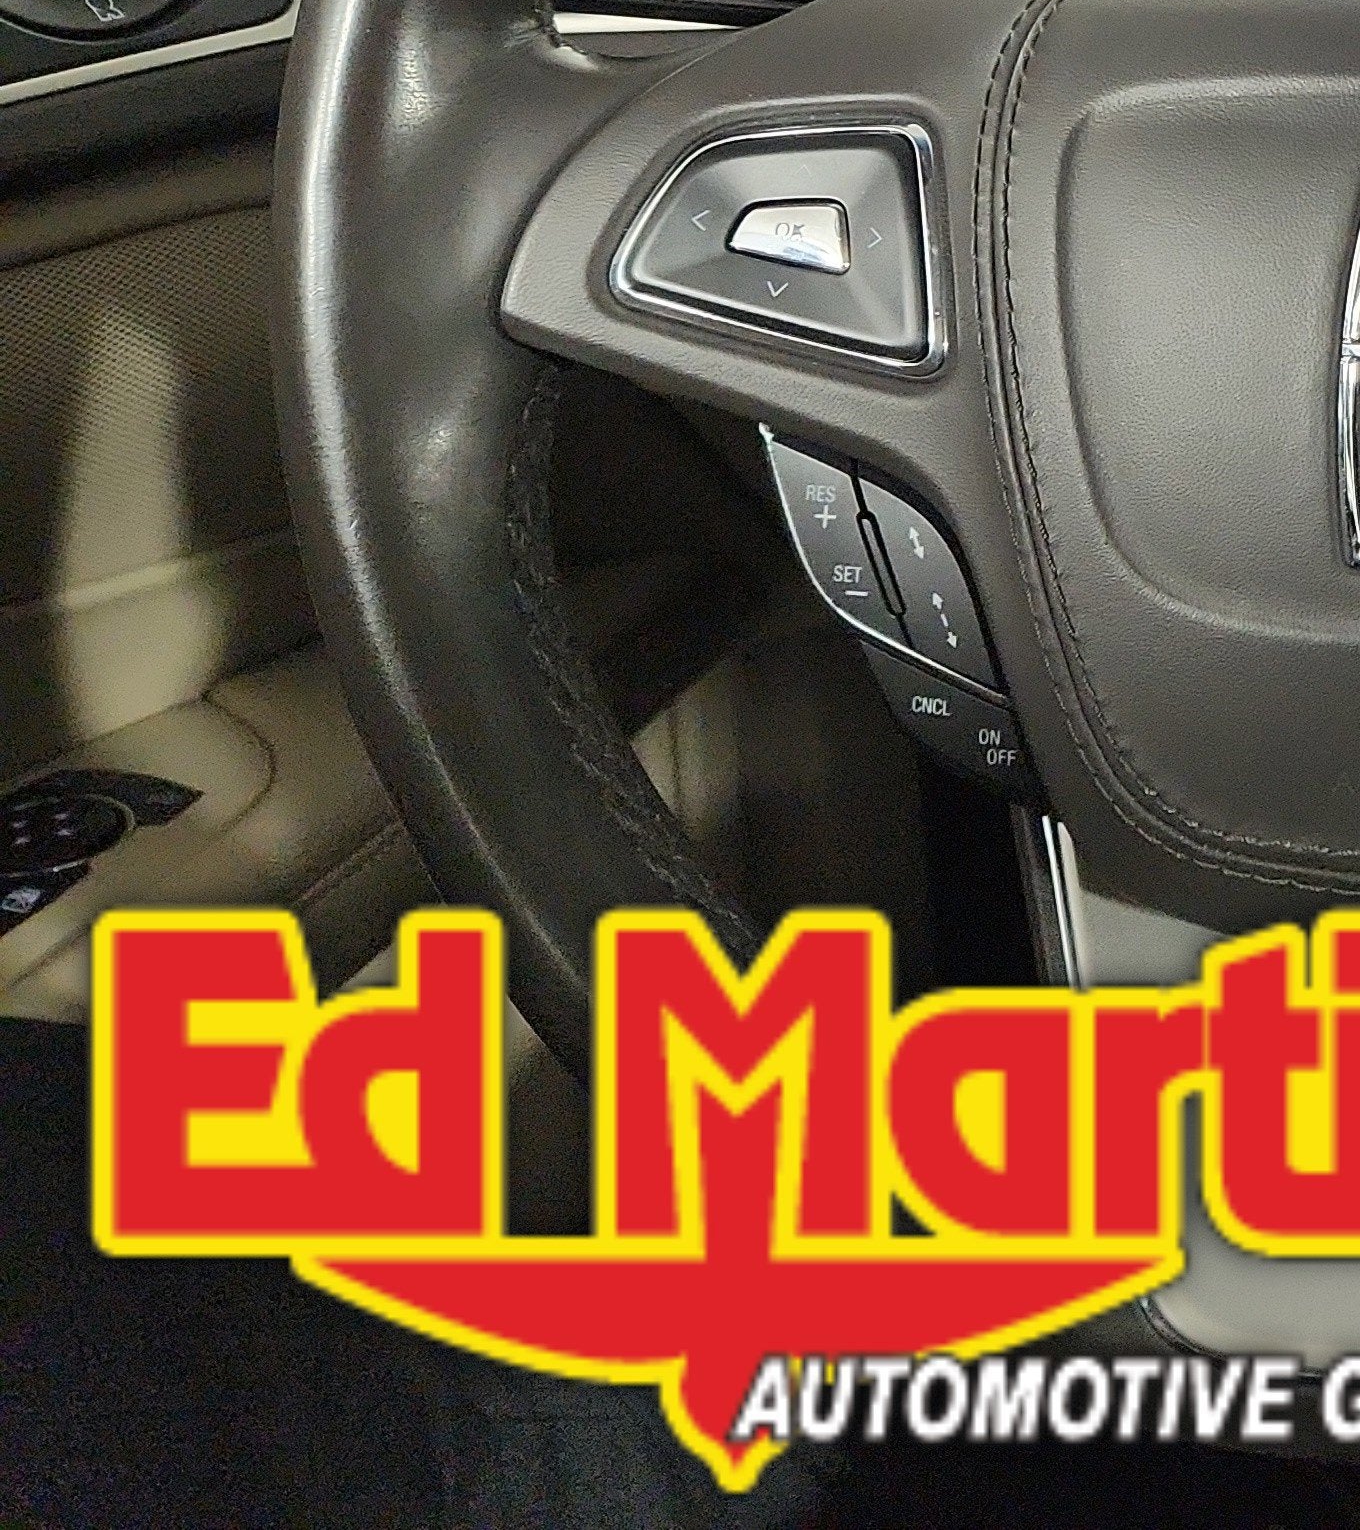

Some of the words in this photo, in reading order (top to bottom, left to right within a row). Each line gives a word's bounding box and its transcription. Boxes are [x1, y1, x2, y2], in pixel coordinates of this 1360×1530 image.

[804, 484, 837, 504] RES
[832, 565, 863, 584] SET
[911, 695, 951, 718] CNCL
[978, 727, 1001, 746] ON
[986, 749, 1018, 768] OFF
